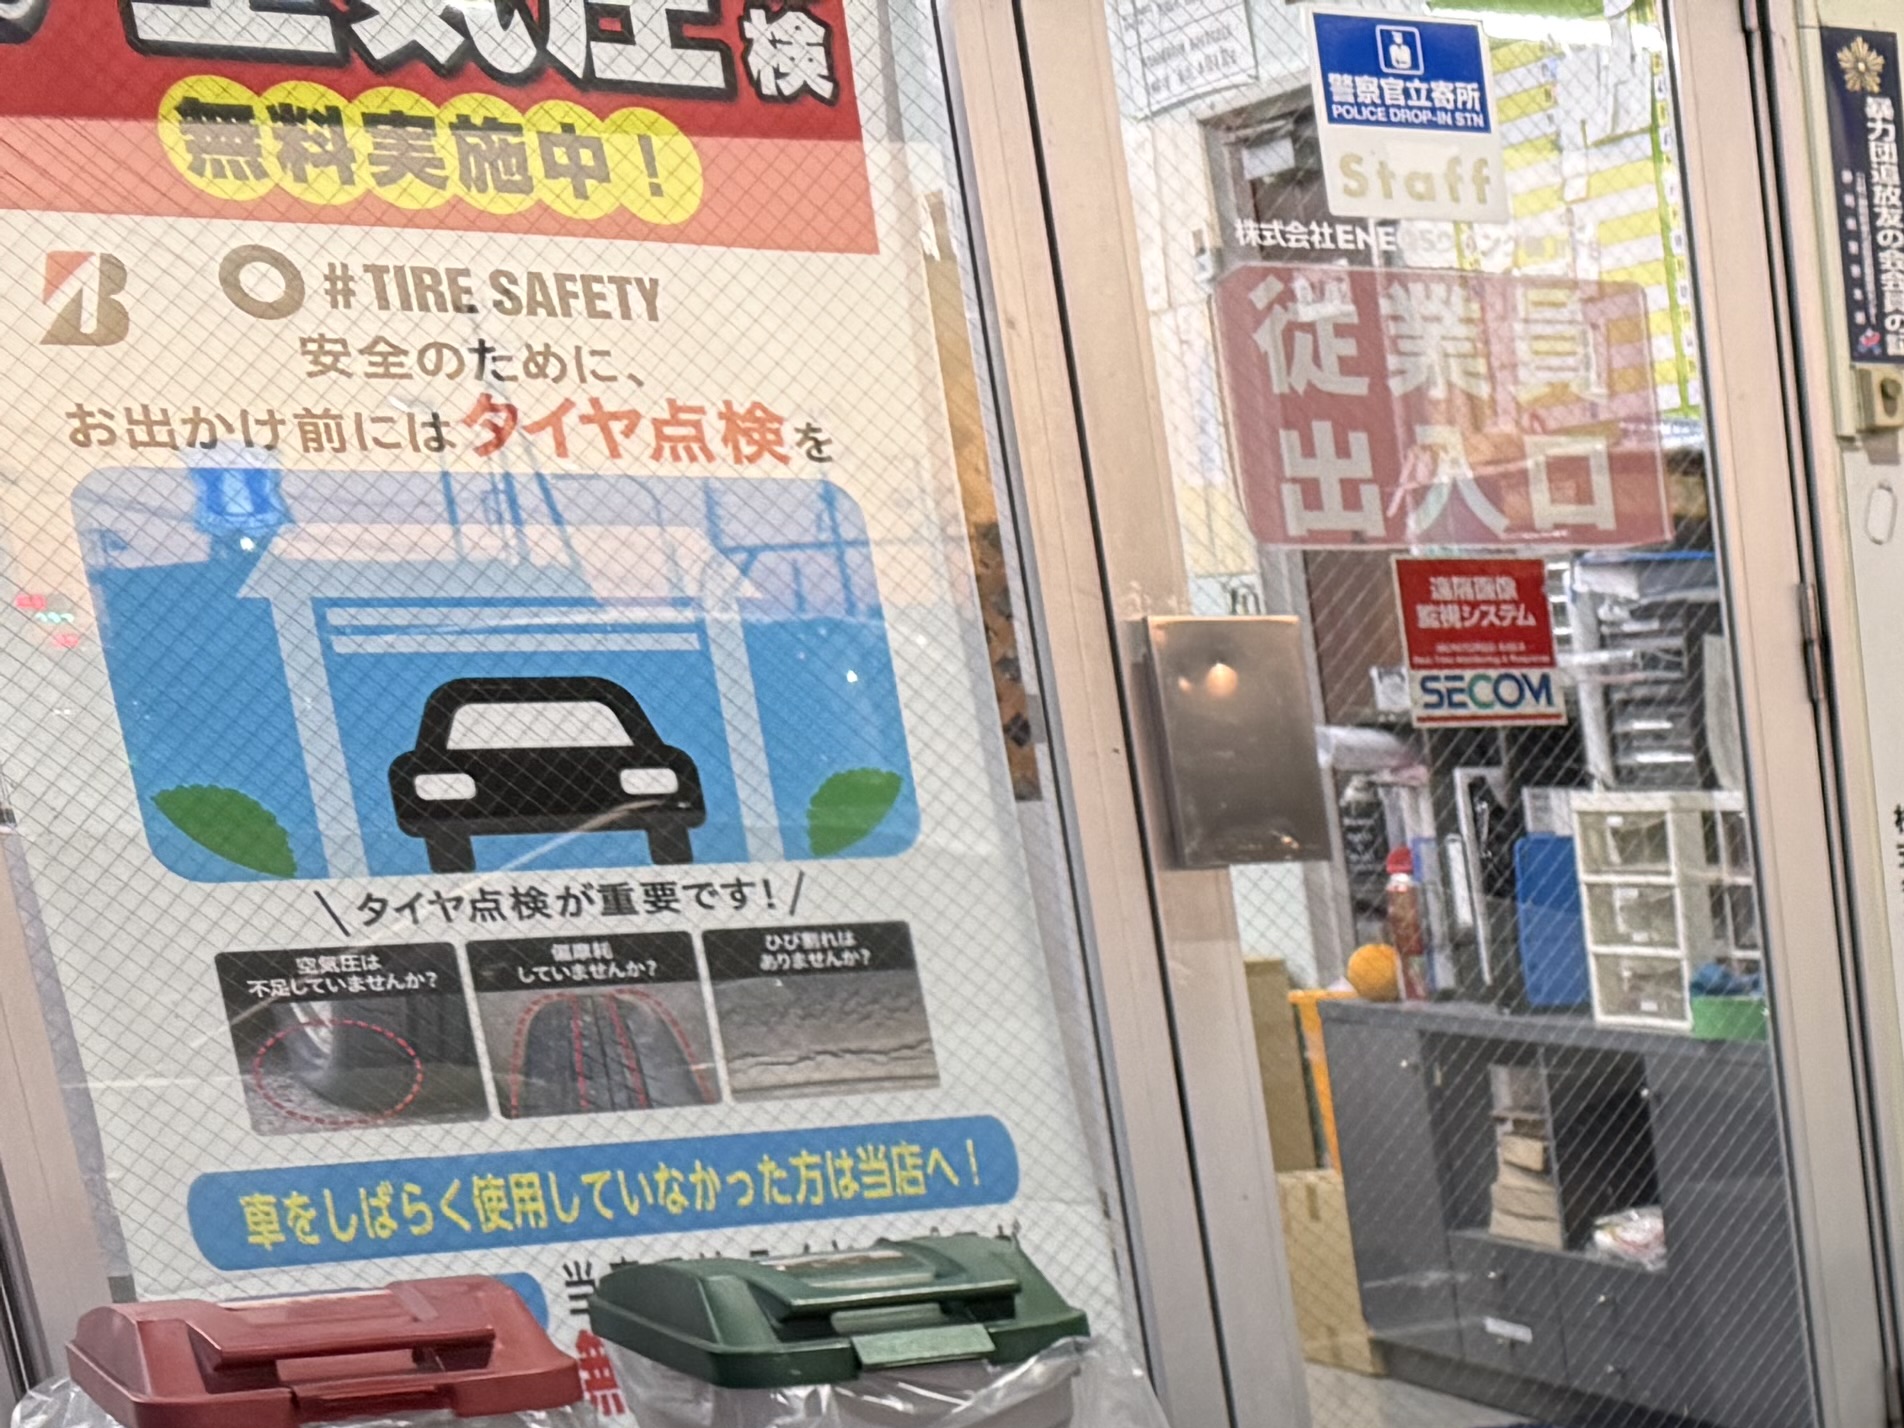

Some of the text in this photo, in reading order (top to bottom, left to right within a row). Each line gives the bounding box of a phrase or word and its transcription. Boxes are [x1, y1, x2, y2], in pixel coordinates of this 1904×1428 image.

[1327, 72, 1481, 112] 警察官立寄所
[1331, 104, 1485, 128] POLICE DROP-IN STN
[1338, 152, 1491, 205] Staff
[491, 268, 662, 323] SAFETY
[299, 334, 647, 387] 安全のために、
[1249, 273, 1610, 399] 従業員
[66, 394, 836, 466] お出かけ前にはタイヤ点検を
[1279, 420, 1620, 540] 出入口
[1419, 672, 1556, 711] SECOM
[296, 953, 382, 975] 空気圧は
